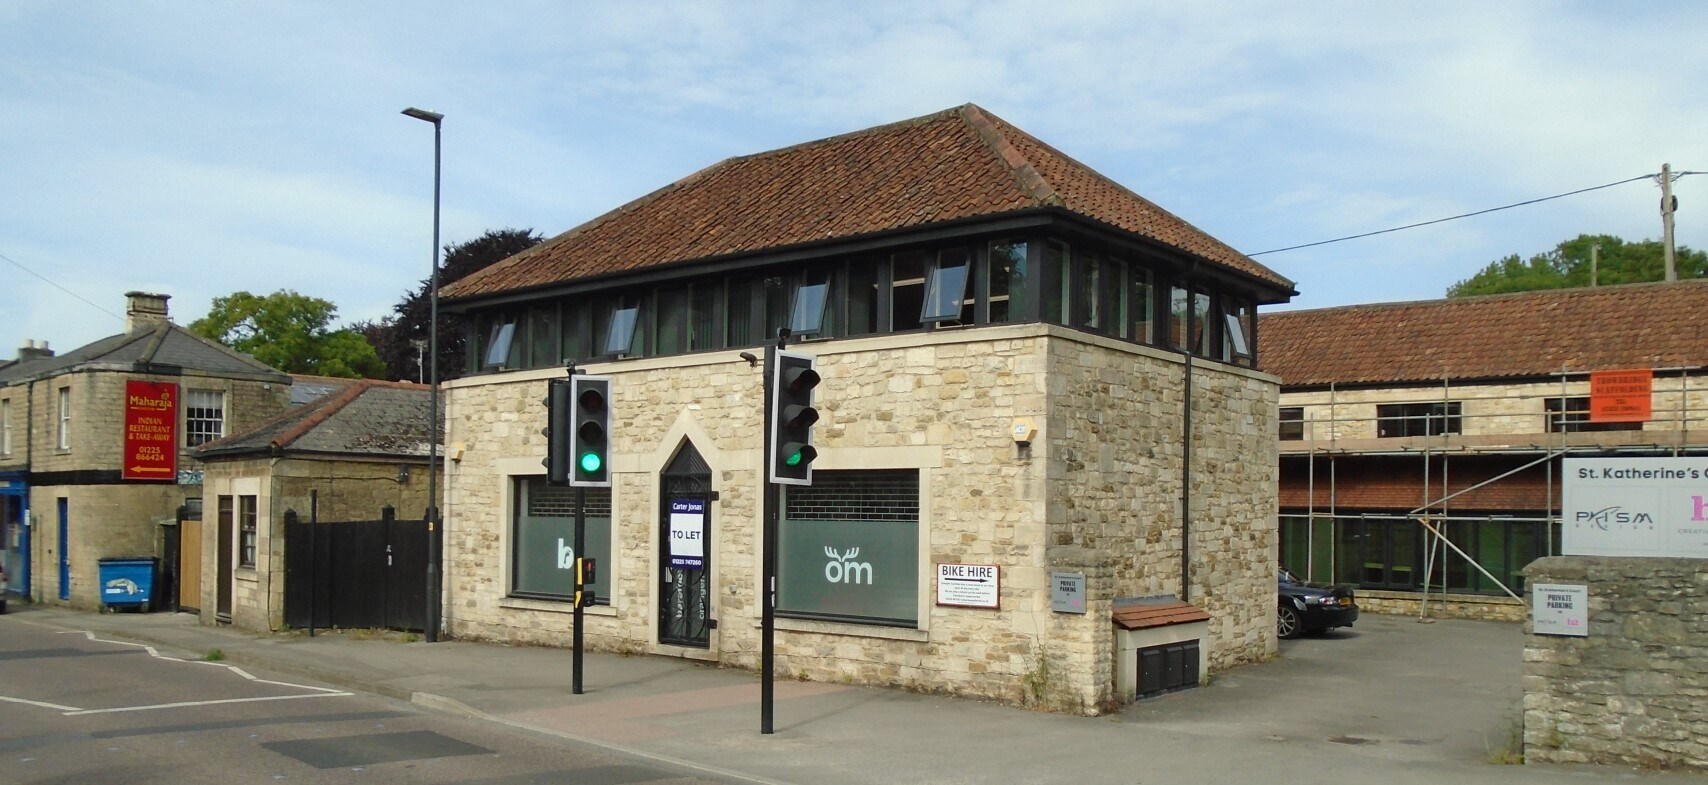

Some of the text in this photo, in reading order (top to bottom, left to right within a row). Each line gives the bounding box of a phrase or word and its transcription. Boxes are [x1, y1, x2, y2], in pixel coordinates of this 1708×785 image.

[130, 395, 172, 410] Maharaja
[138, 417, 162, 425] INDIAN
[129, 425, 170, 433] RESTAURANT
[136, 433, 170, 441] TAKE-AWAY
[139, 446, 161, 454] 01225
[1578, 468, 1599, 479] St.
[1603, 467, 1700, 479] Katherine's
[688, 503, 702, 511] Jonas
[1576, 507, 1653, 526] PRISM
[672, 531, 701, 539] TO LET
[825, 561, 873, 585] om
[942, 565, 993, 578] BIKE HIRE
